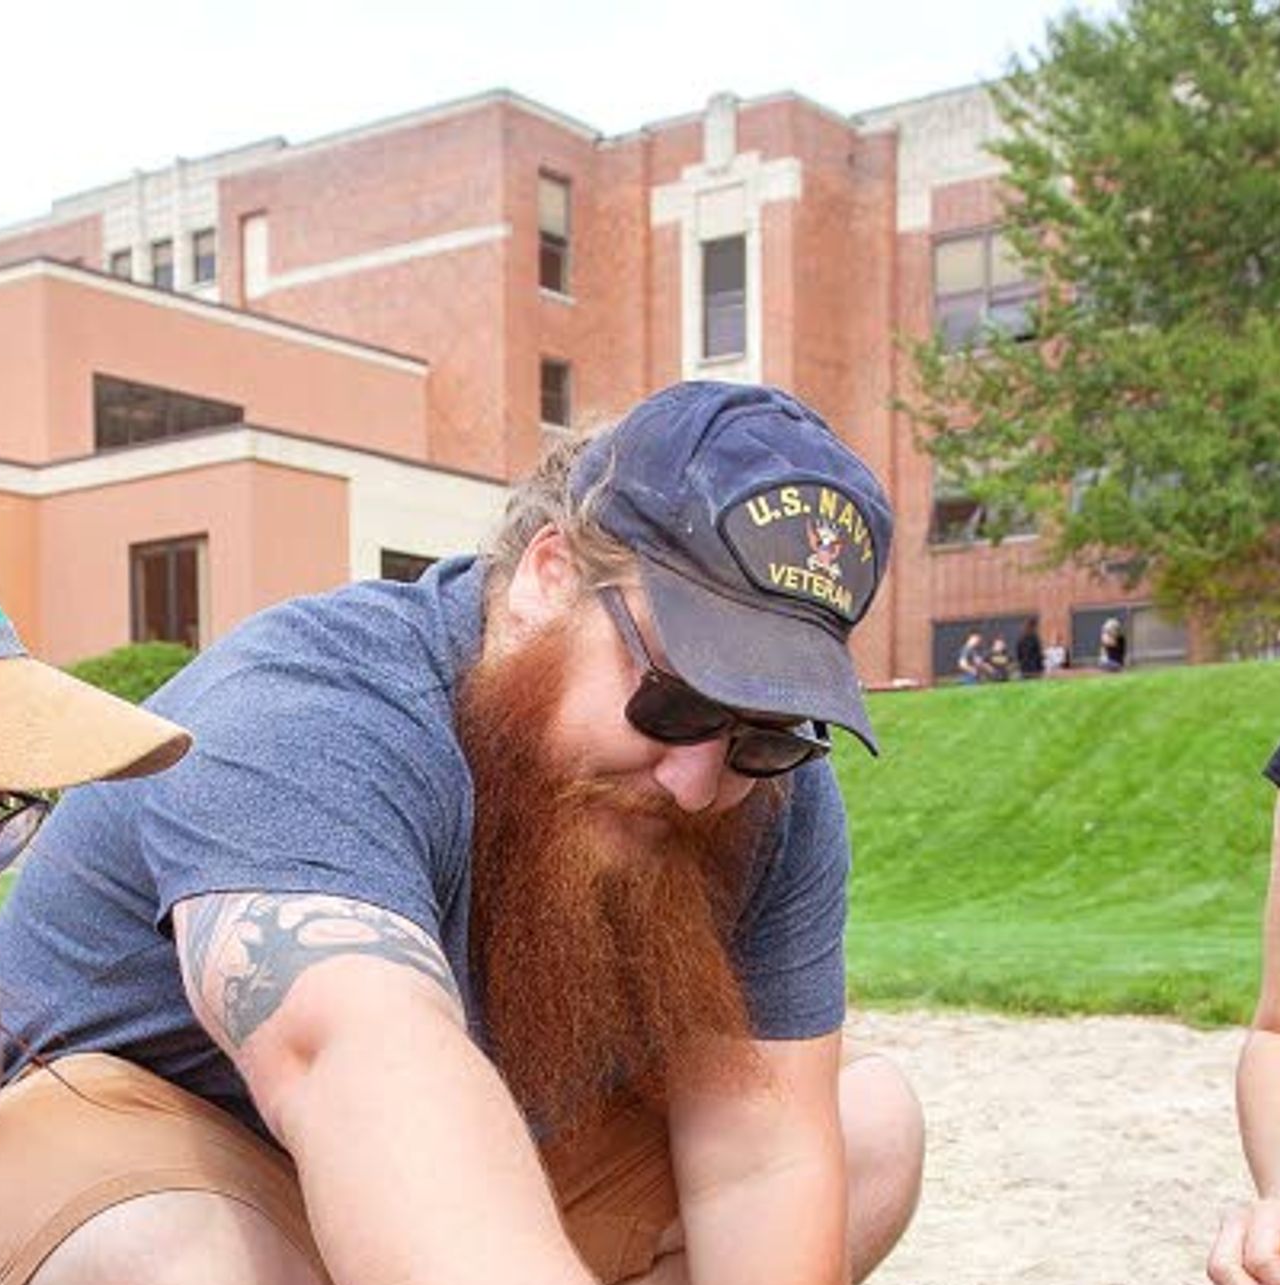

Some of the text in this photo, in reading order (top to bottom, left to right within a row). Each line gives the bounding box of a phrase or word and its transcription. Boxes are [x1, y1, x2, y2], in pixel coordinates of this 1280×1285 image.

[745, 486, 872, 563] U.S. NAVY
[769, 562, 854, 613] VETERAN
